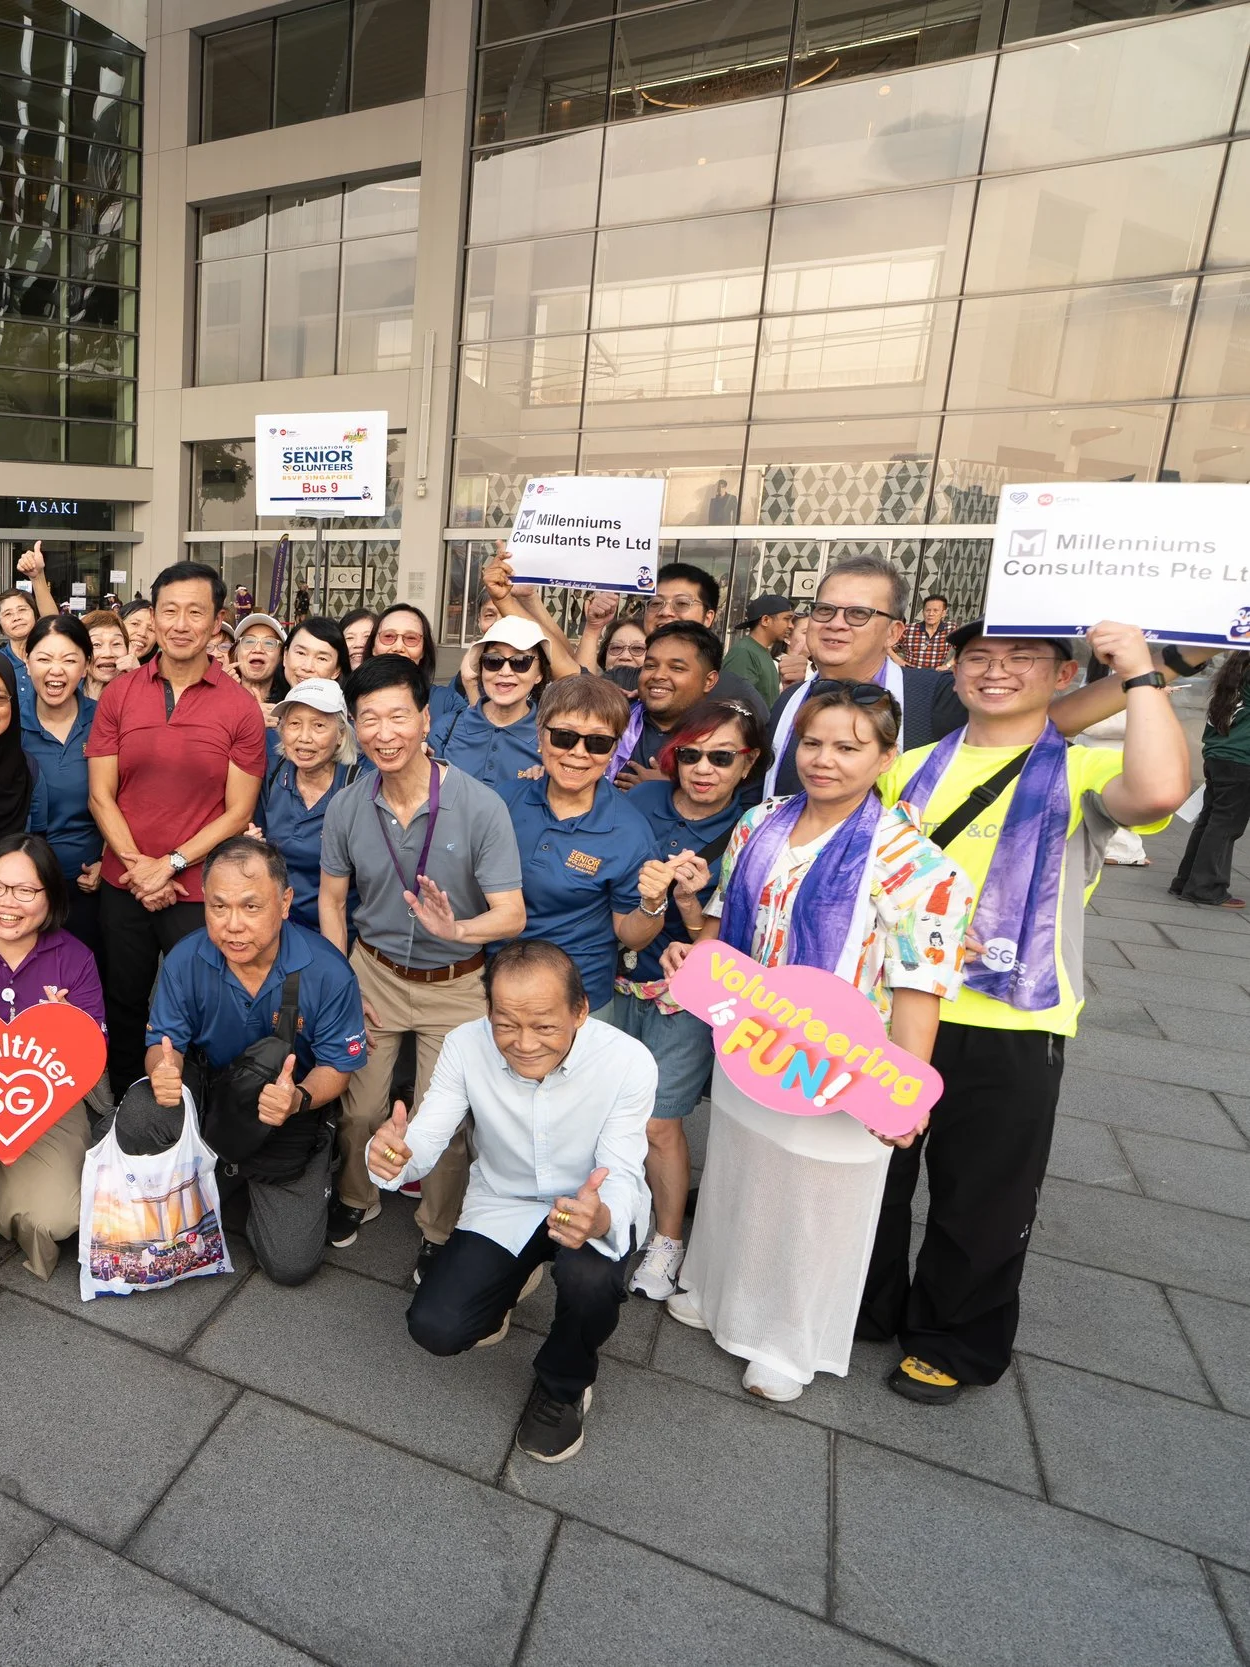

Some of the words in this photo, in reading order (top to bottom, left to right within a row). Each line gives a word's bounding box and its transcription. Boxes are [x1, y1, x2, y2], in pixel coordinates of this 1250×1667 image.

[282, 450, 353, 464] SENIOR
[302, 482, 327, 494] Bus
[330, 482, 339, 493] 9
[16, 500, 78, 514] TASAKI
[536, 513, 622, 530] Millenniums
[512, 531, 591, 548] Consultants
[596, 535, 621, 549] Pte
[626, 537, 651, 551] Ltd
[1056, 534, 1217, 554] Millenniums
[1003, 559, 1160, 578] Consultants
[1170, 562, 1212, 580] Pte
[570, 851, 600, 868] SENIOR
[986, 946, 1014, 964] SG
[707, 997, 738, 1027] is
[710, 952, 923, 1107] Volunteering
[721, 1017, 852, 1108] FUN!
